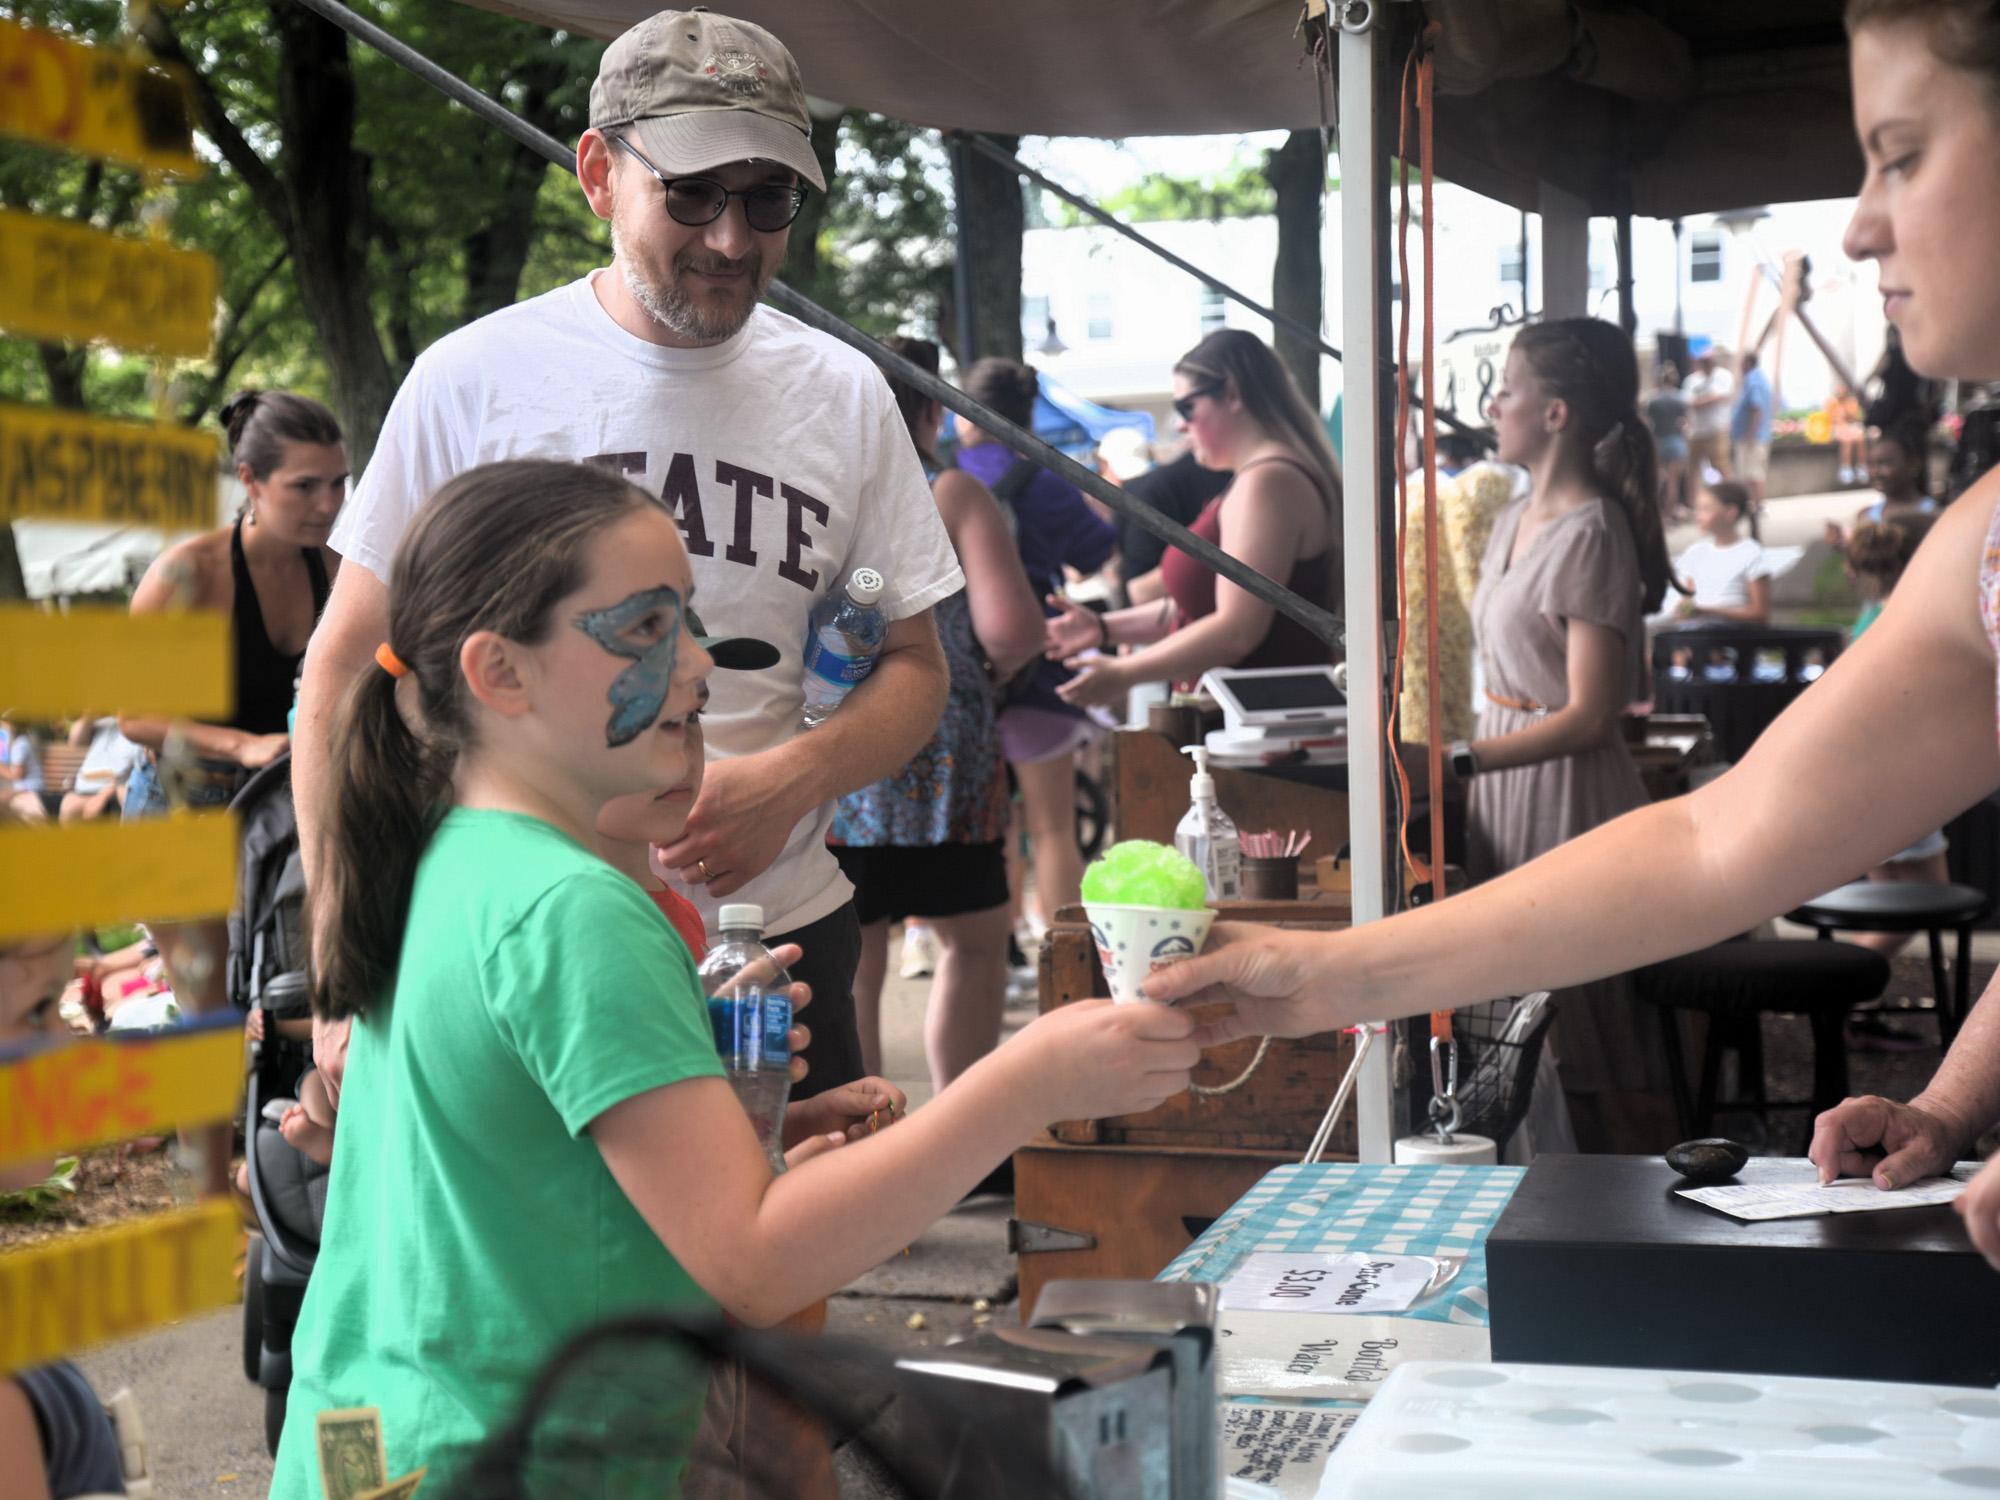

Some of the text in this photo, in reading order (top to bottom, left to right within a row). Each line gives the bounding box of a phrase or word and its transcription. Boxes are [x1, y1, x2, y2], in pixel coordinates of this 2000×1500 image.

[1269, 1269, 1333, 1298] $3.00
[1286, 1339, 1339, 1375] Water
[1344, 1337, 1399, 1382] Bottled
